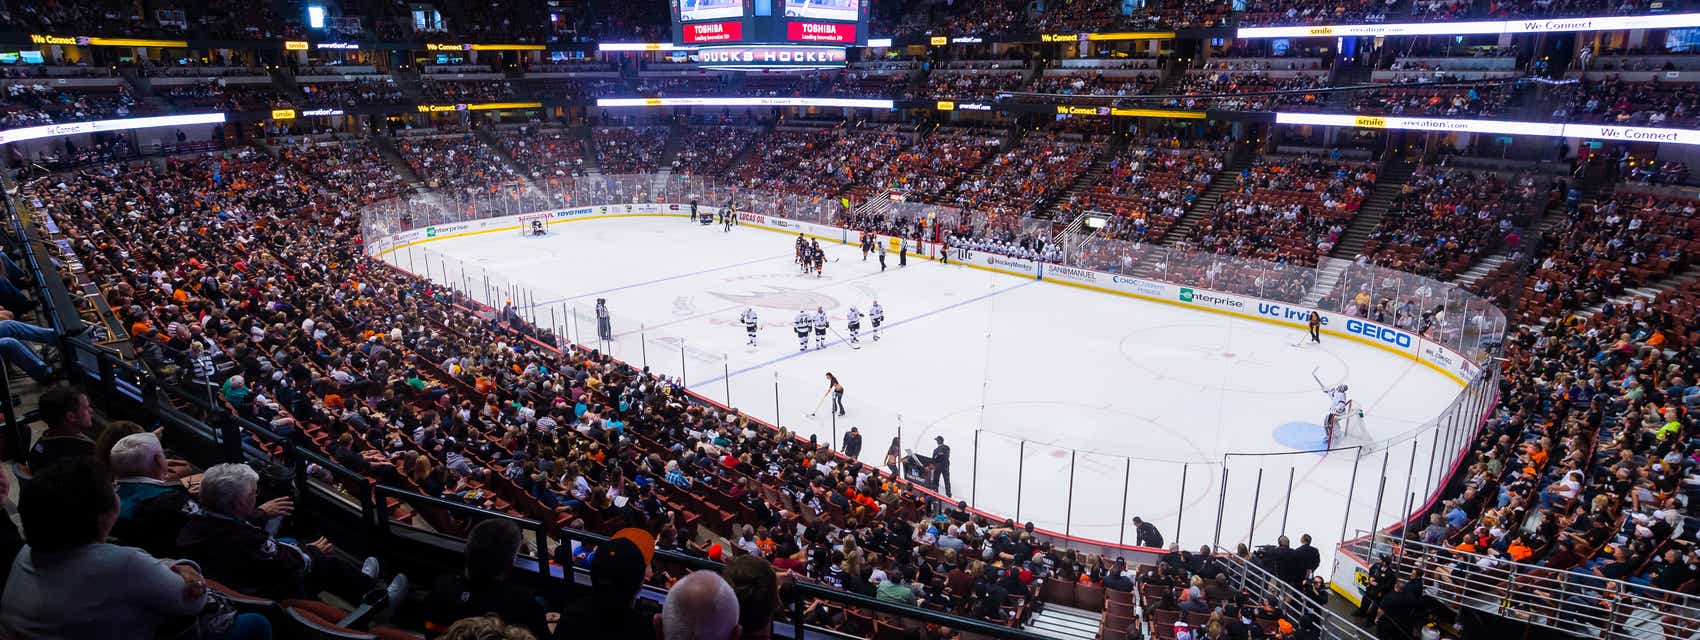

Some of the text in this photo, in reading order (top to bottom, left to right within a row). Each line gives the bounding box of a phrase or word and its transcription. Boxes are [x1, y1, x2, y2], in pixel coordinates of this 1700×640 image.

[694, 24, 723, 33] TOSHIBA
[802, 23, 836, 33] TOSHIBA
[1525, 21, 1592, 30] We Connect
[31, 34, 77, 45] We Connect
[1041, 33, 1077, 42] We Connect
[427, 43, 438, 51] We
[703, 51, 835, 62] DUCKS HOCKEY
[430, 104, 455, 112] Connect
[1057, 106, 1097, 115] We Connect
[1358, 118, 1384, 127] smile
[1601, 128, 1678, 141] We Connect
[740, 212, 756, 222] LUCAS
[756, 215, 765, 224] OIL
[1181, 288, 1243, 308] enterprise
[1258, 302, 1329, 326] UC Irvie
[1346, 319, 1411, 348] GEICO
